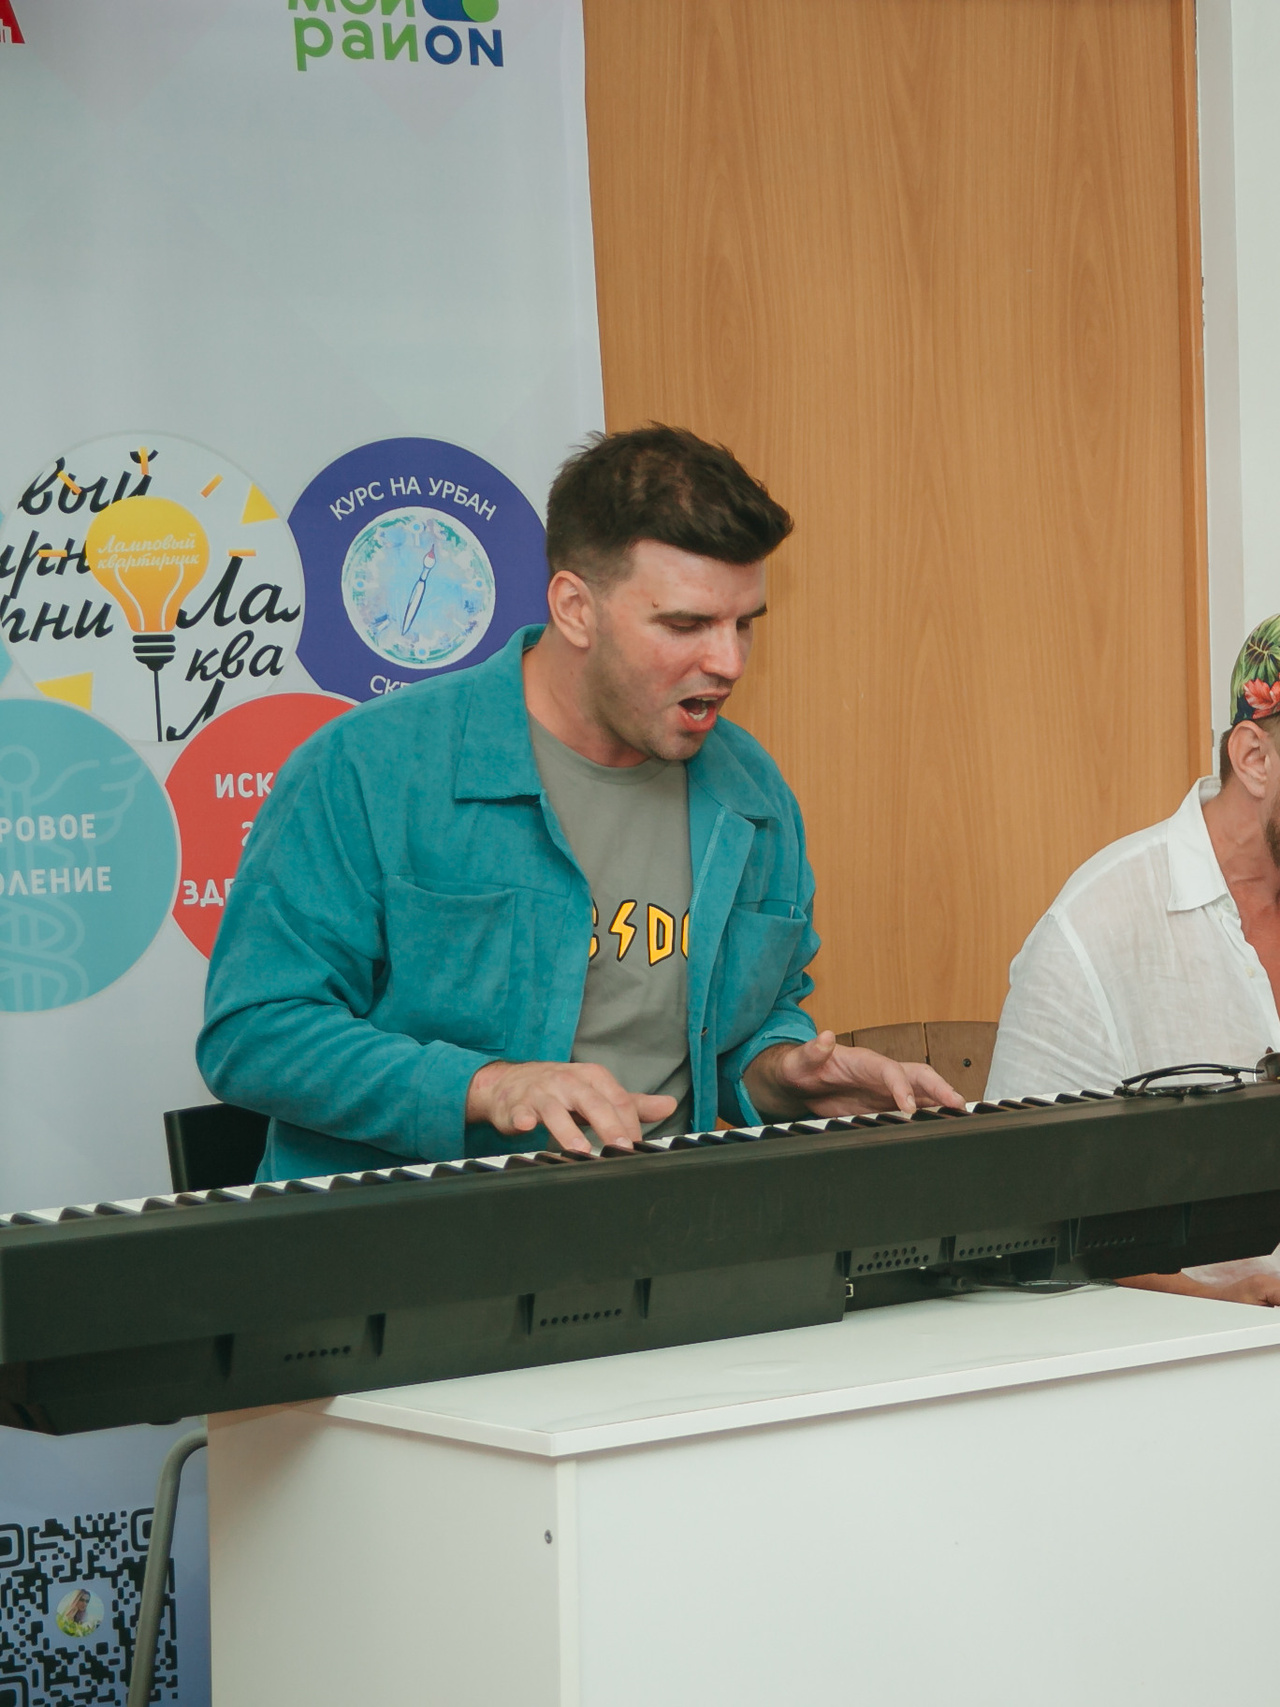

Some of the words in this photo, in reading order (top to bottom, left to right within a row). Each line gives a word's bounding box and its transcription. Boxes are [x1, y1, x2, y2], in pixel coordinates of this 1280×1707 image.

[329, 481, 385, 521] КУРС
[389, 476, 422, 497] НА
[428, 477, 498, 521] УРБАН
[97, 532, 197, 554] Ламповый
[97, 553, 201, 573] квартирник
[184, 629, 285, 682] ква
[369, 674, 412, 695] СК
[0, 865, 113, 897] ЛЕНИЕ
